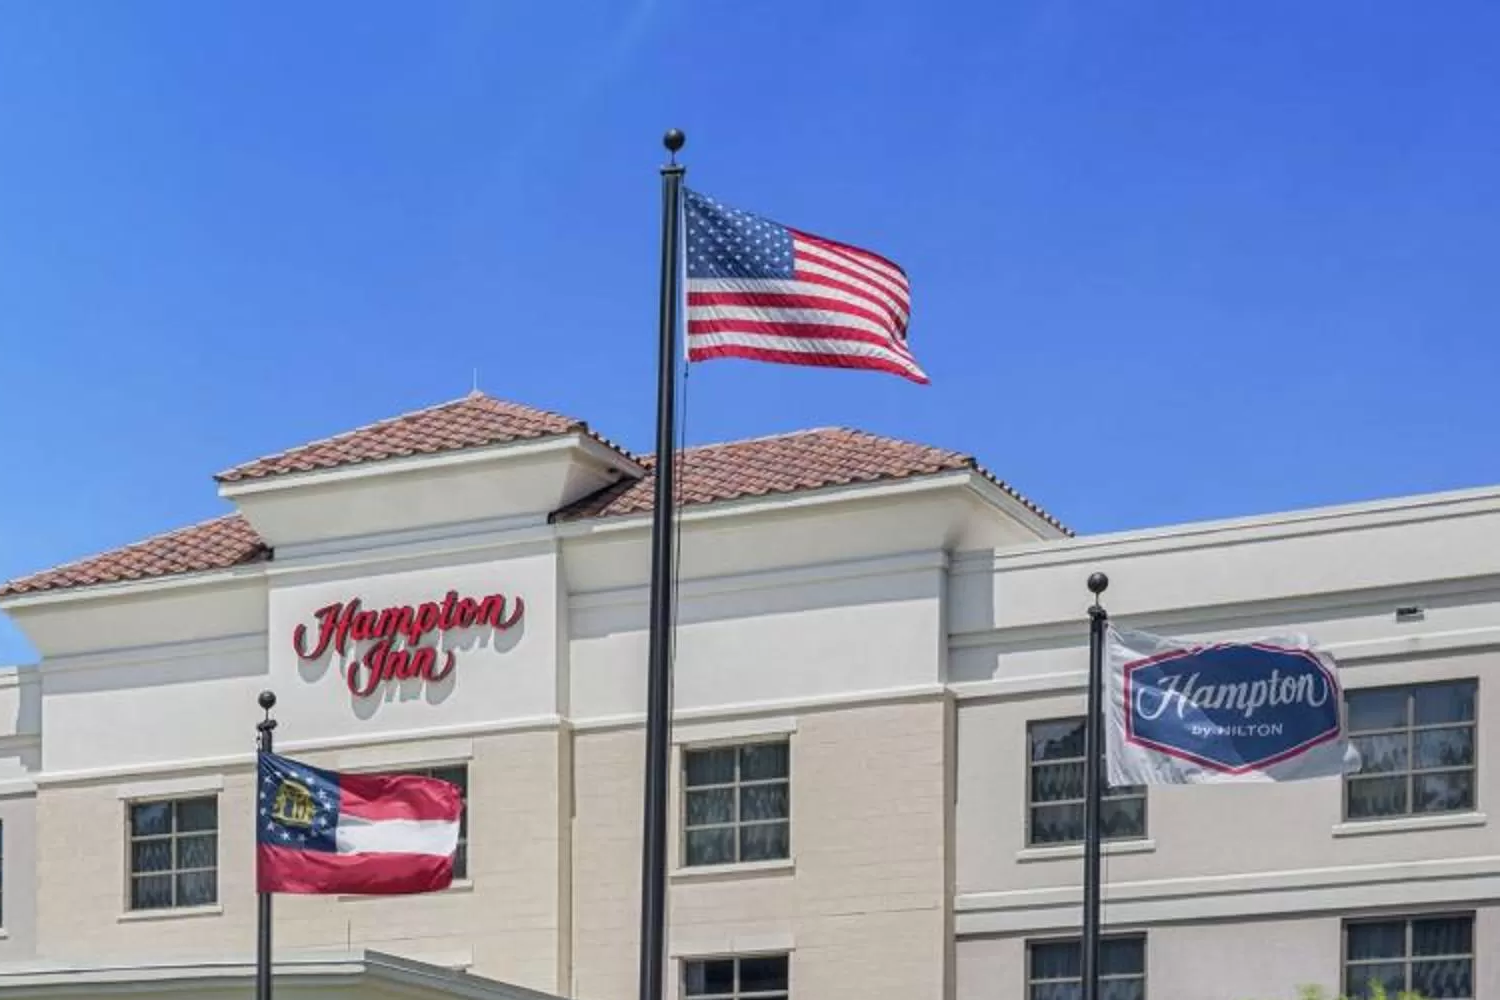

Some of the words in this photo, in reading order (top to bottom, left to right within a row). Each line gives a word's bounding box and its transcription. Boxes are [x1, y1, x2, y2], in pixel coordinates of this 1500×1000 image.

[293, 589, 525, 660] Hampton
[347, 639, 456, 697] Inn
[1136, 668, 1329, 721] Hampton
